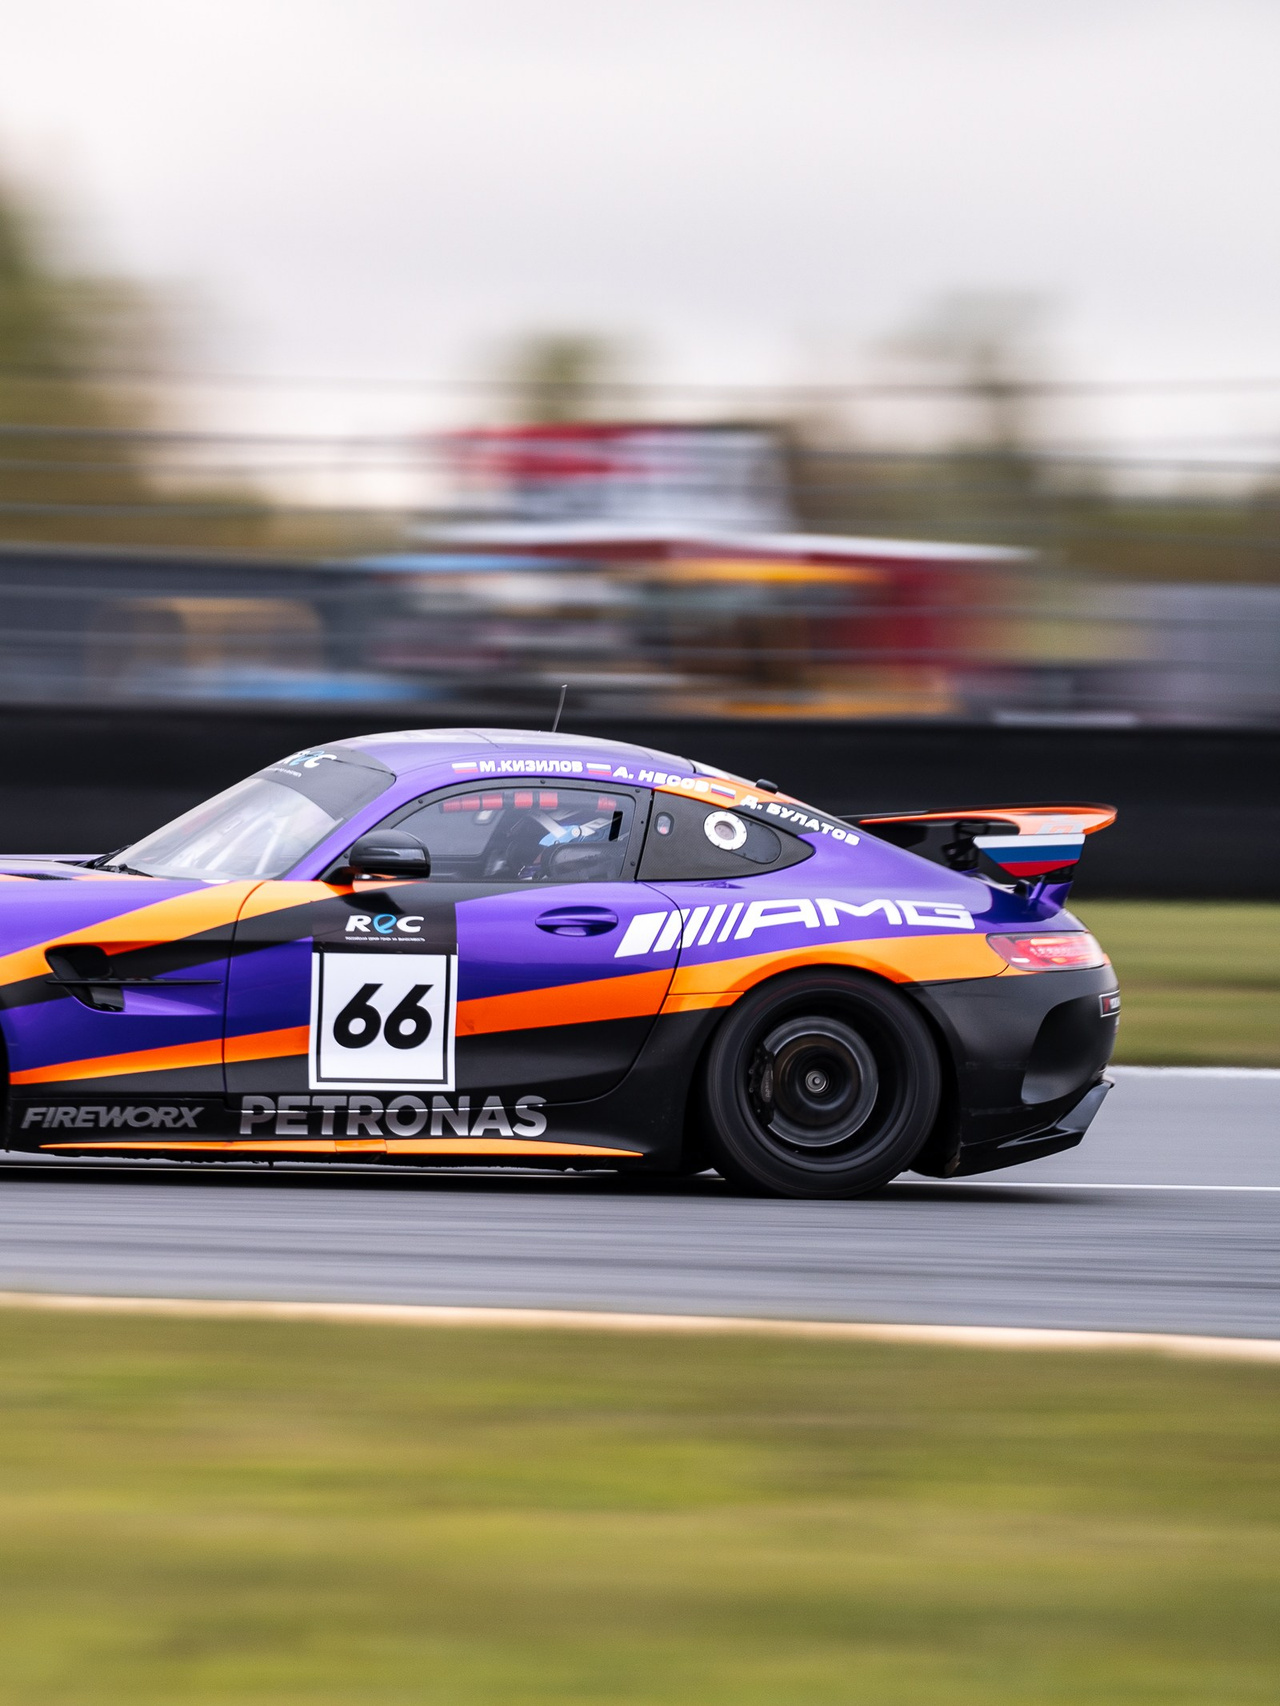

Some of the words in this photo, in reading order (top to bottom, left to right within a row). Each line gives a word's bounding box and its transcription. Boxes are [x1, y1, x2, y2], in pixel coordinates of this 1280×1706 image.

[479, 760, 584, 773] М.КИЗИЛОВ
[612, 766, 635, 780] А.
[638, 769, 710, 792] НЕСОВ
[740, 794, 763, 811] Д.
[766, 802, 860, 846] БУЛАТОВ
[734, 899, 975, 940] AMG
[333, 983, 434, 1050] 66
[239, 1095, 547, 1137] PETRONAS
